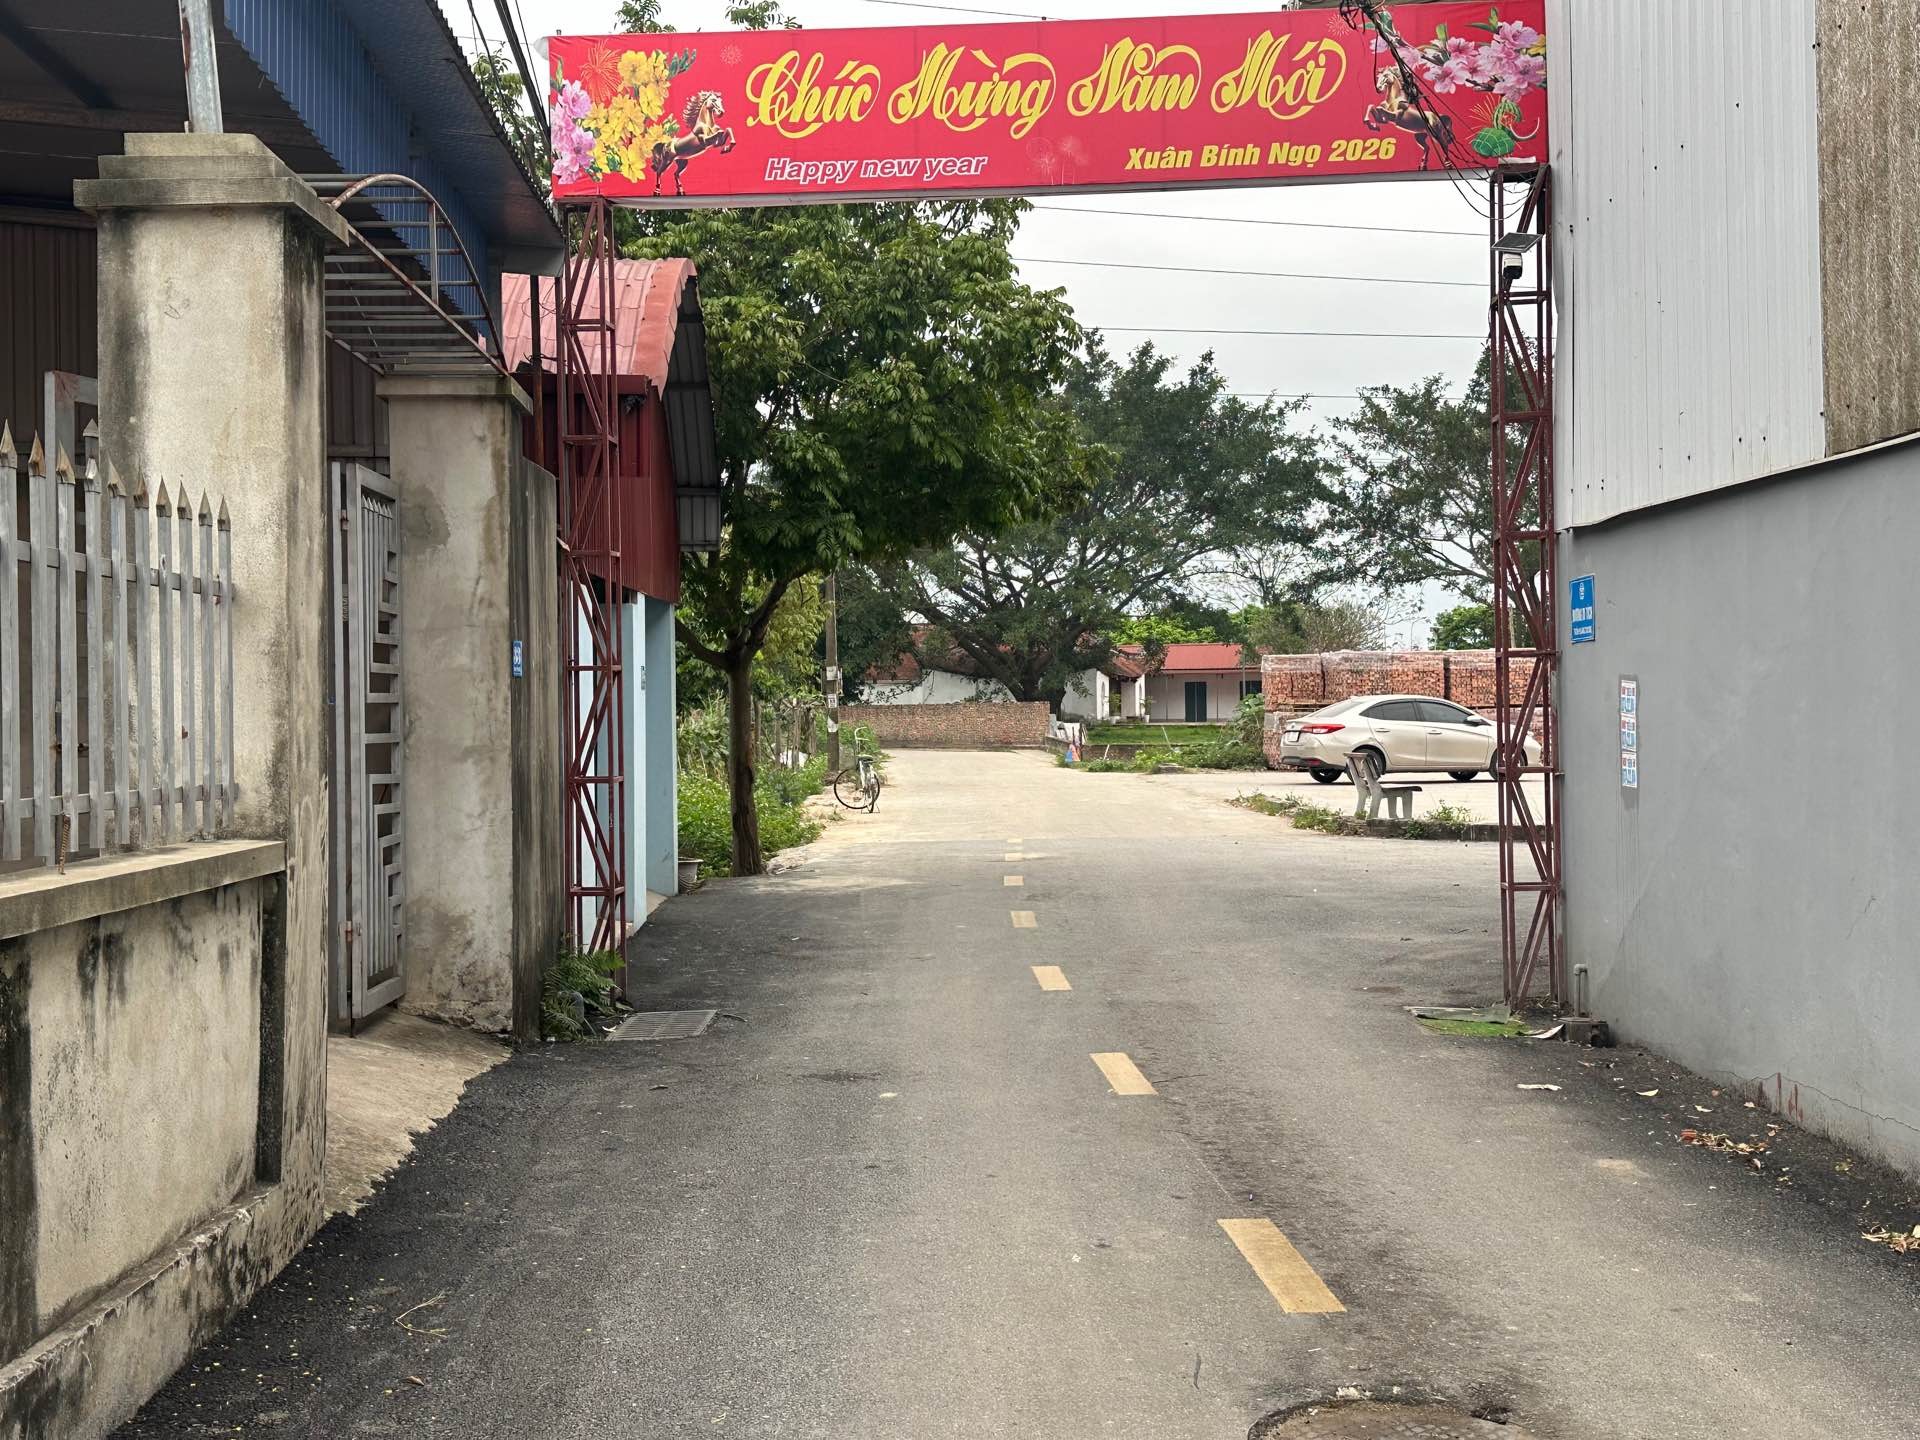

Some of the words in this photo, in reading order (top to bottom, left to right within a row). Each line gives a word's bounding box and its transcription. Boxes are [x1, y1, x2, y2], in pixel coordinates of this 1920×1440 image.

[745, 50, 882, 138] Chúc
[887, 42, 1057, 139] Mừng
[1067, 37, 1202, 117] Năm
[1210, 30, 1347, 120] Mới
[765, 157, 858, 184] Happy
[861, 159, 919, 178] new
[924, 156, 988, 181] year
[1124, 144, 1193, 170] Xuân
[1199, 141, 1261, 167] Bính
[1268, 141, 1322, 168] Ngọ
[1327, 137, 1397, 161] 2026
